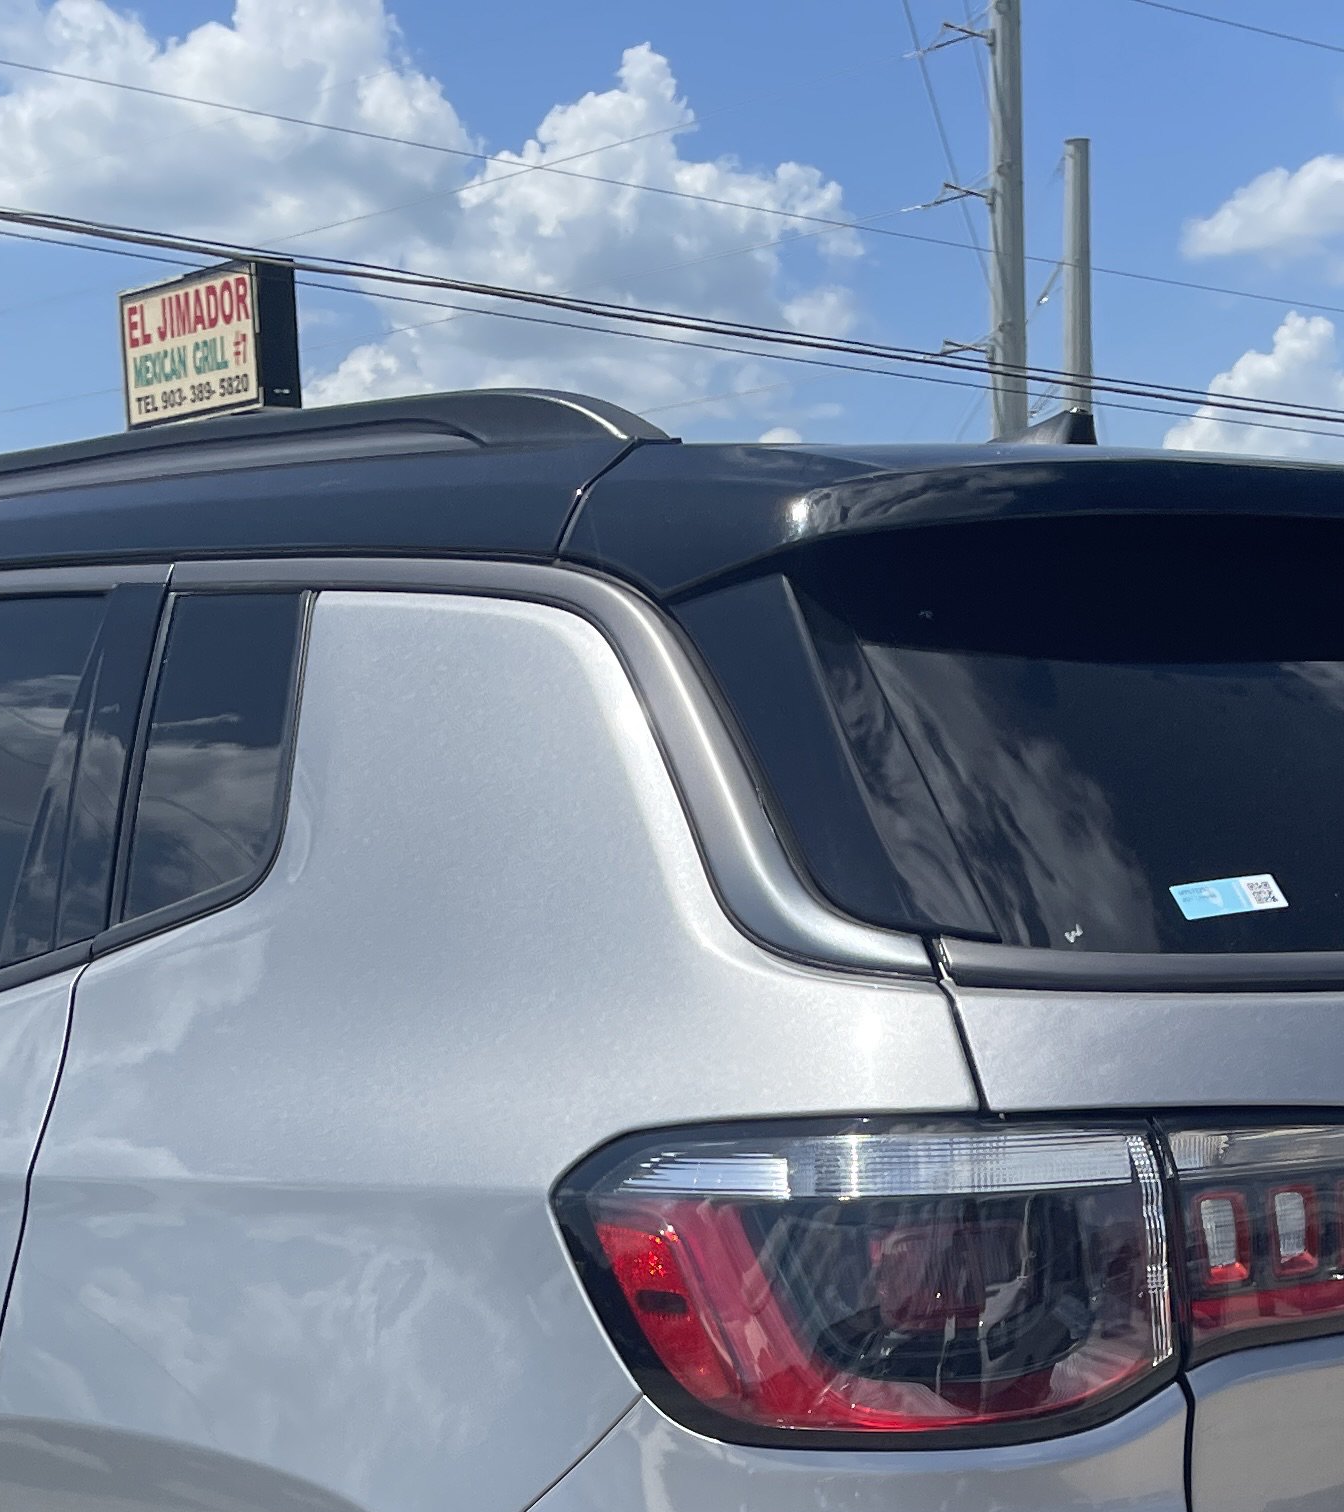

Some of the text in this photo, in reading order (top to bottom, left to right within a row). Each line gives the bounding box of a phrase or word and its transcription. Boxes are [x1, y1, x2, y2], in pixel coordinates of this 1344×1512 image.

[127, 277, 251, 348] EL JIMADOR
[133, 345, 188, 389] MEXICAN
[193, 335, 229, 375] GRILL
[219, 373, 249, 397] 5820
